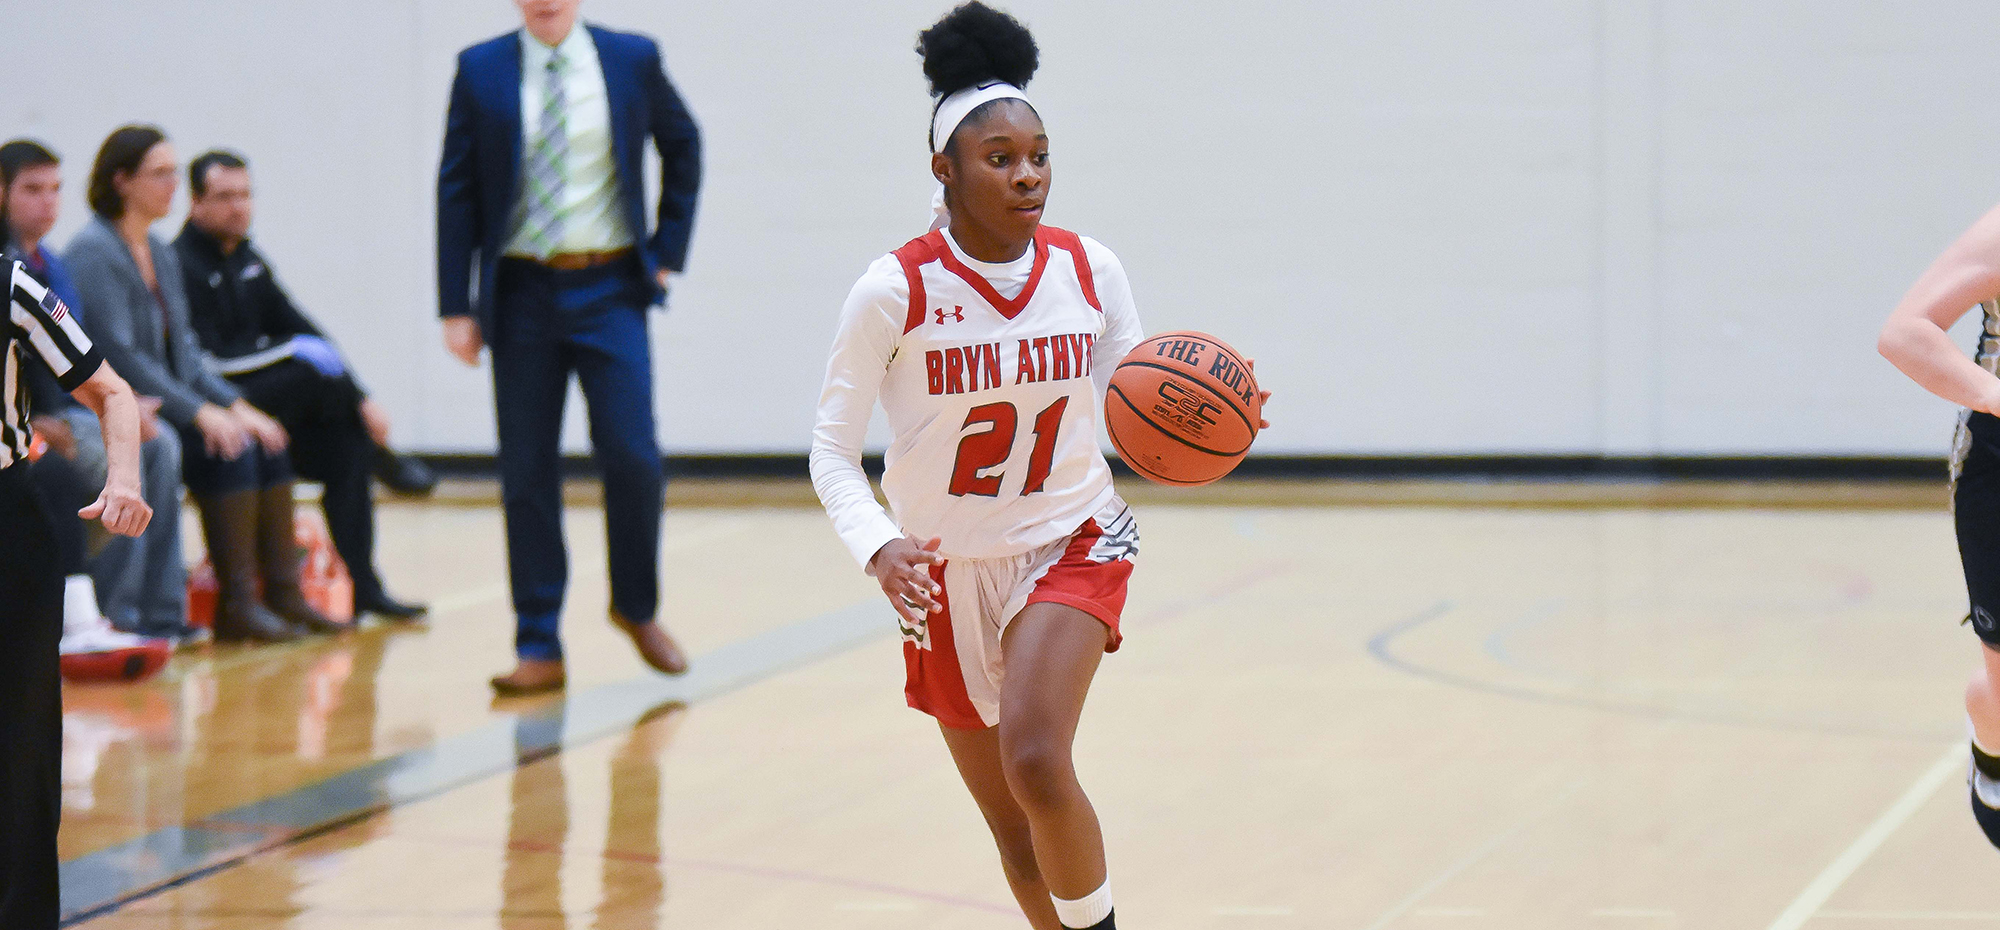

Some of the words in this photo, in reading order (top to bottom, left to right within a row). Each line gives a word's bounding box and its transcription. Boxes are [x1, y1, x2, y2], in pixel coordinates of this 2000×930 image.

[925, 341, 1002, 395] BRYN
[1156, 340, 1206, 367] THE
[1208, 351, 1254, 408] ROCK
[1158, 381, 1222, 426] C2C
[947, 395, 1070, 498] 21
